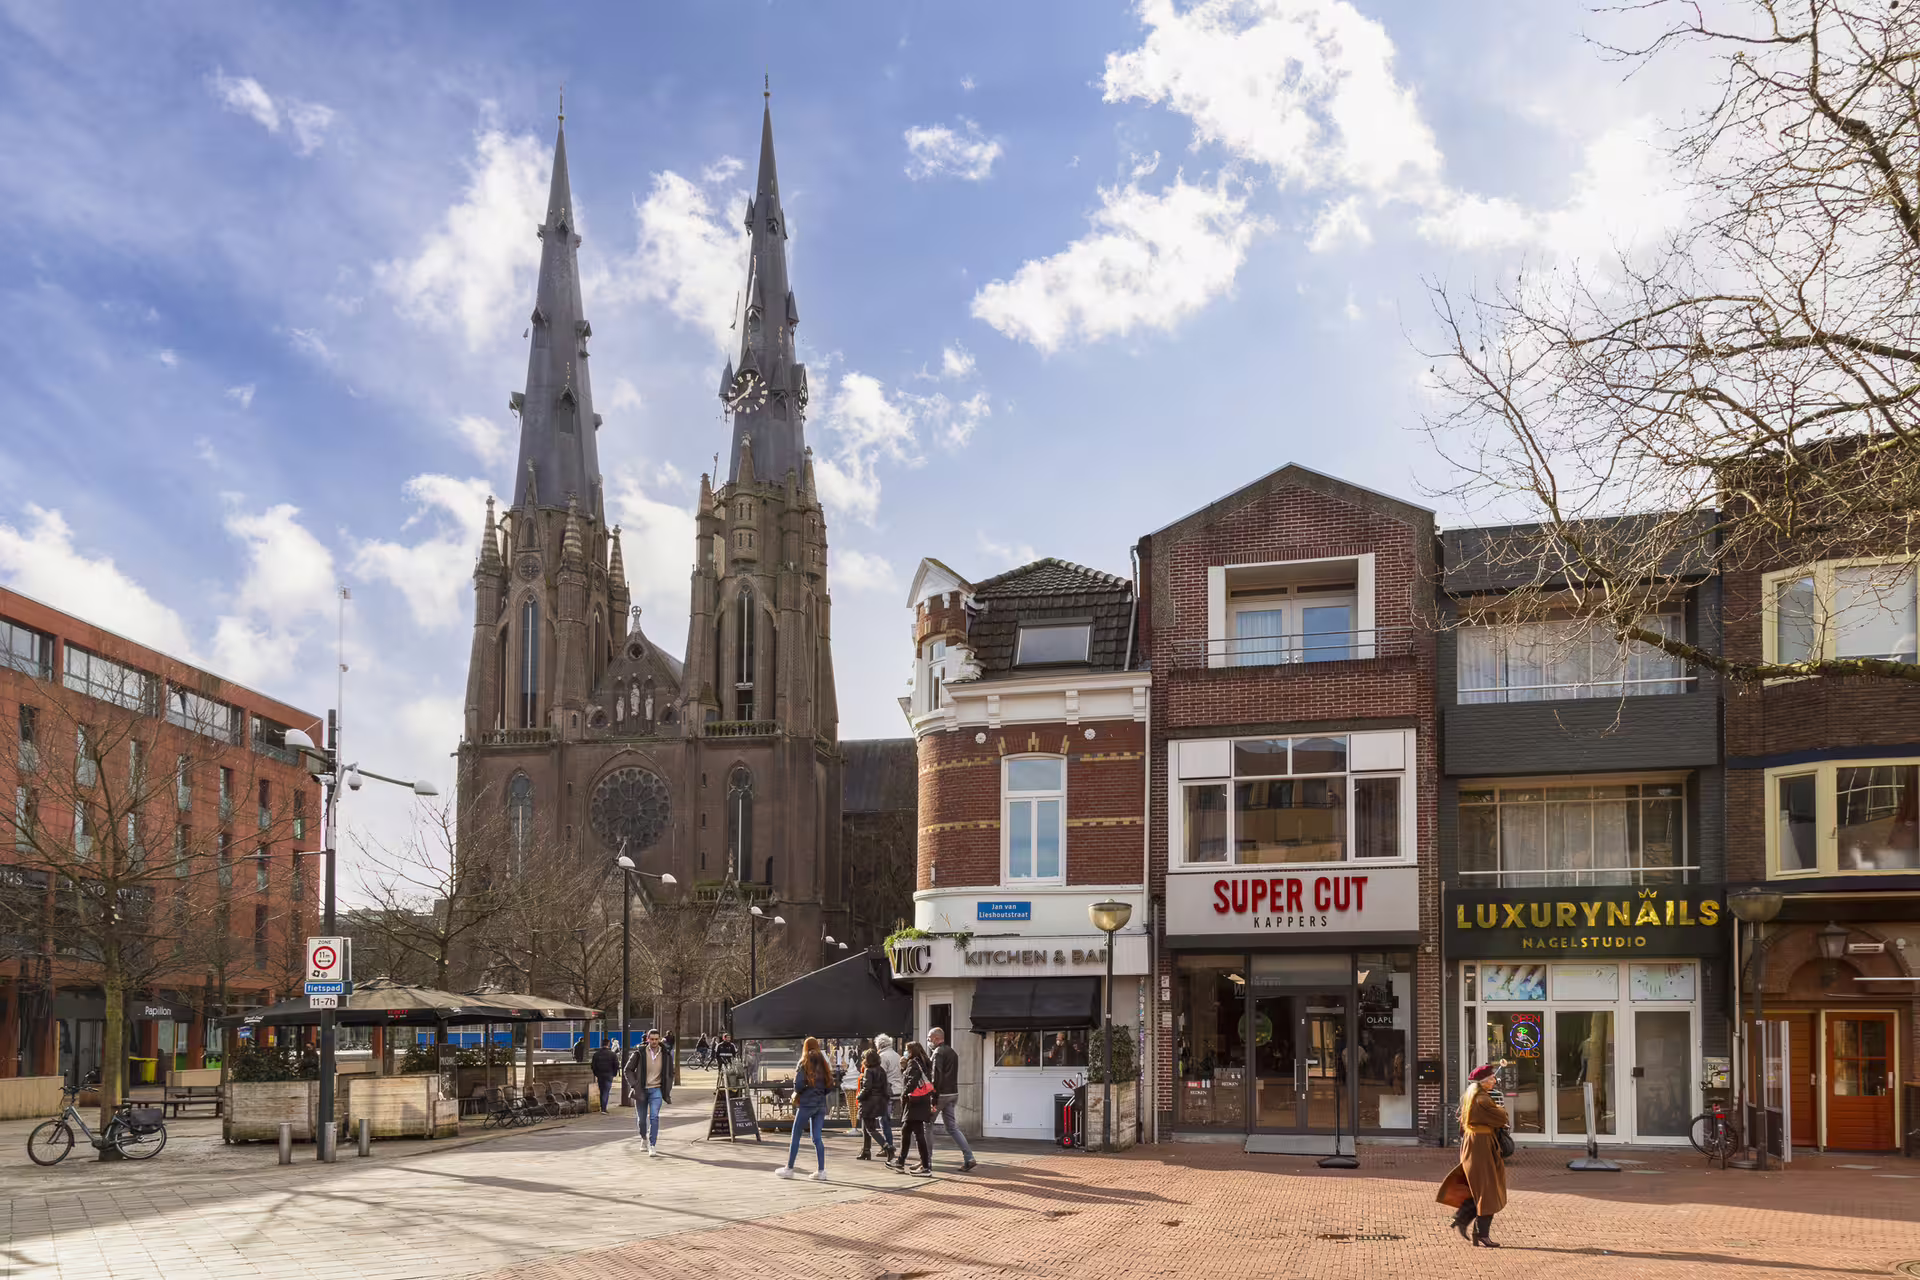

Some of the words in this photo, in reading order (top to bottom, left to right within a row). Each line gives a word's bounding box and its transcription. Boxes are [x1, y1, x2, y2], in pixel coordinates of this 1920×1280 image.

[1213, 878, 1303, 914] SUPER
[1314, 876, 1368, 912] CUT
[1456, 900, 1720, 929] LUXURYNAILS
[1253, 915, 1327, 928] KAPPERS
[1522, 936, 1647, 949] NAGELSTUDIO
[888, 945, 932, 975] VIC
[964, 949, 1048, 966] KITCHEN
[1052, 949, 1067, 965] &
[307, 984, 341, 993] fietspad
[312, 997, 336, 1006] 11-7h
[144, 1005, 172, 1016] Papillon
[1511, 1013, 1541, 1023] OPEN
[1509, 1047, 1541, 1058] NAILS
